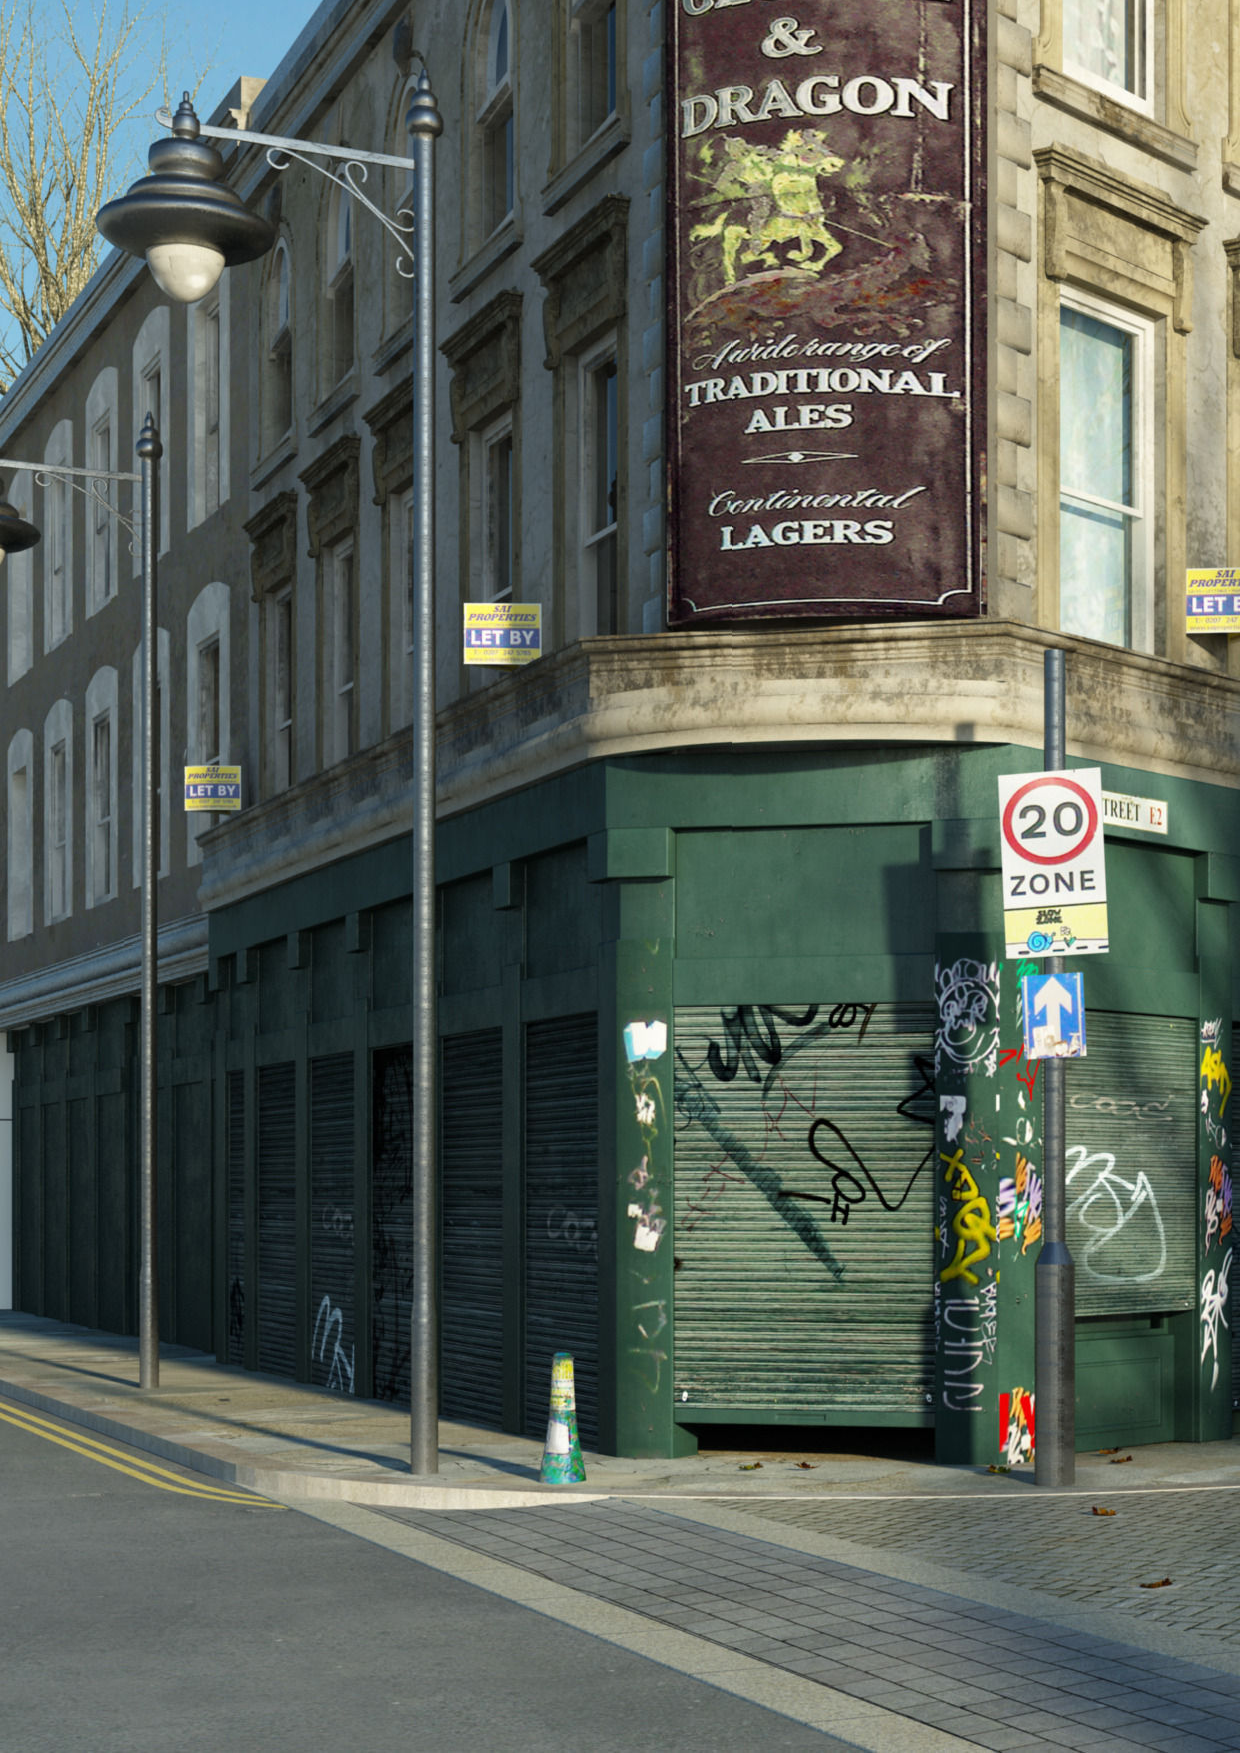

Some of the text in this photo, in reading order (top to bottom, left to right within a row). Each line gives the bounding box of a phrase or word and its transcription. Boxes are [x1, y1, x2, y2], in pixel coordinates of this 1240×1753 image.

[761, 17, 823, 58] &
[681, 75, 954, 138] DRAGON
[685, 367, 961, 407] TRADITIONAL
[744, 404, 853, 434] ALES
[708, 486, 927, 517] Continental
[720, 520, 893, 551] LAGERS
[1216, 570, 1236, 578] SAI
[493, 605, 512, 613] SAI
[1191, 596, 1227, 613] LET
[468, 614, 537, 622] PROPERTIES
[471, 630, 534, 645] LET BY
[189, 785, 235, 797] LET BY
[1019, 801, 1083, 839] 20
[1102, 798, 1141, 822] TREET
[1010, 870, 1096, 896] ZONE
